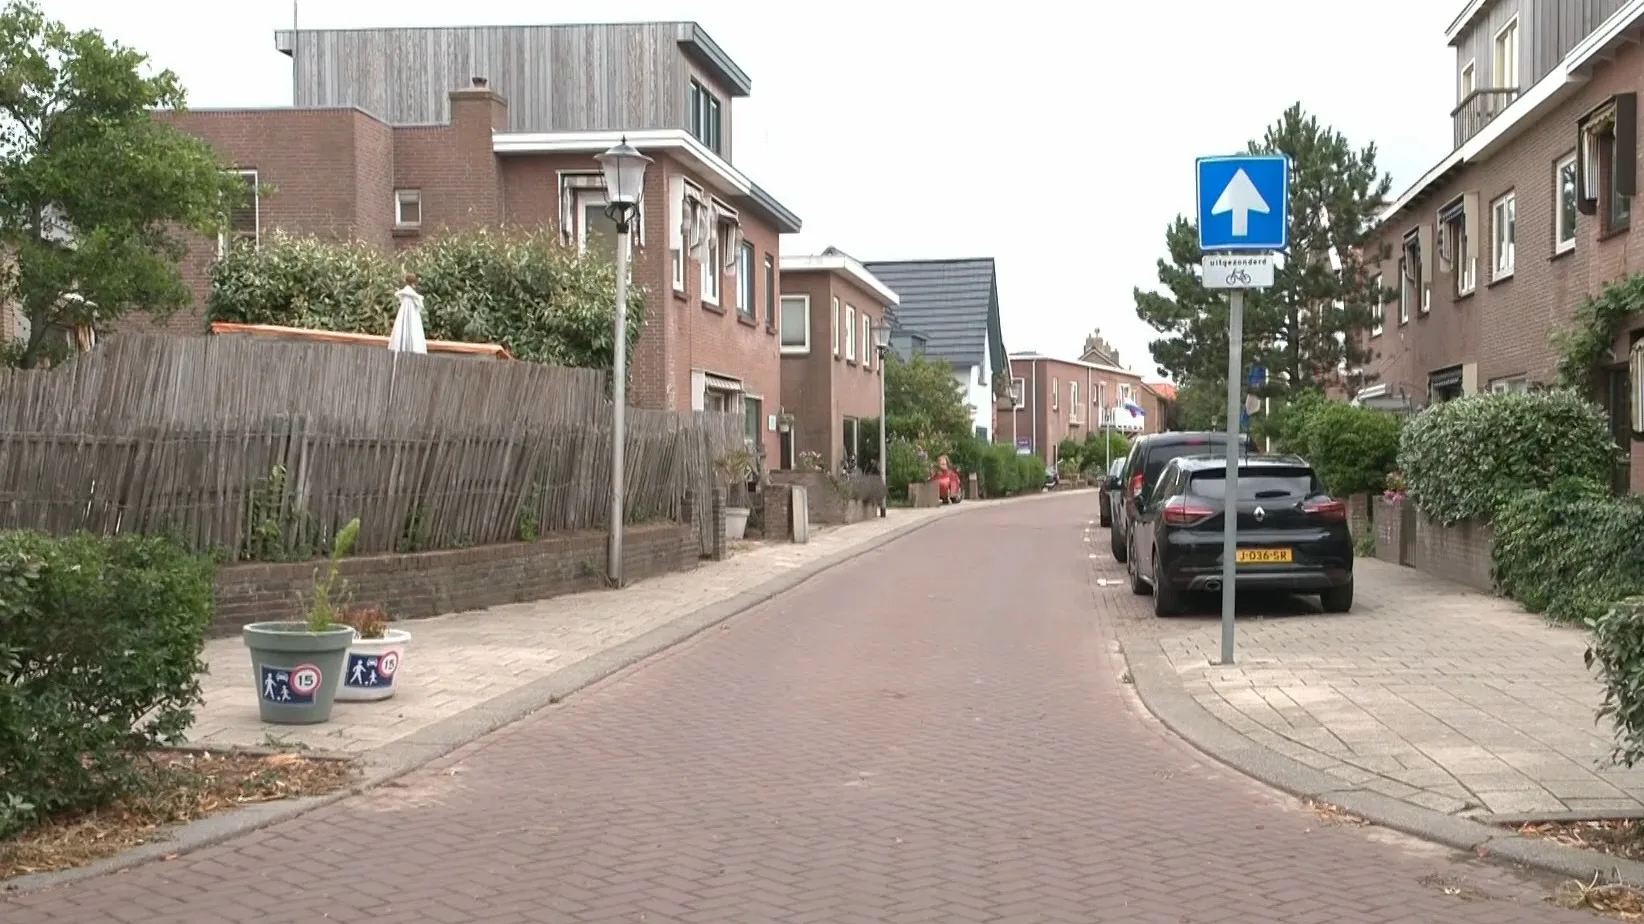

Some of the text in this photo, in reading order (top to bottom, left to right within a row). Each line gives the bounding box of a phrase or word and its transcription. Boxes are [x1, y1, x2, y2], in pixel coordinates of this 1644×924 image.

[1210, 258, 1267, 267] uitgezonderd
[384, 659, 395, 671] 15
[298, 675, 313, 687] 15
